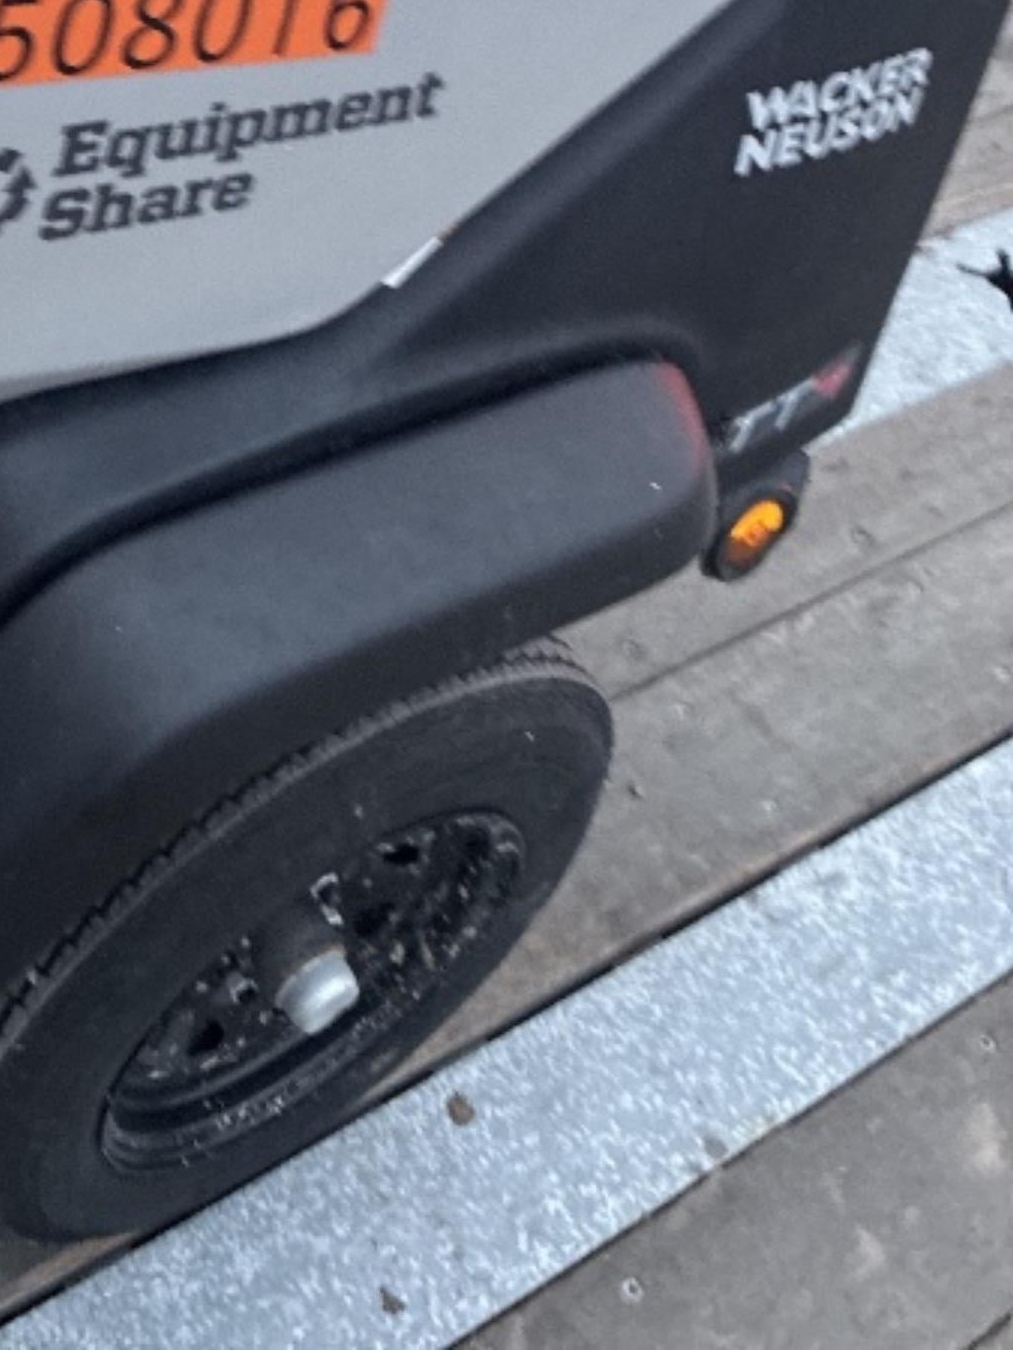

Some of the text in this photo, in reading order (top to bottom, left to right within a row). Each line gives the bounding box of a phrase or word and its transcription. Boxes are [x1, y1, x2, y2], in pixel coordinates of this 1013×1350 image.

[53, 72, 445, 178] Equipment
[734, 86, 925, 177] NEUSON
[746, 47, 934, 132] WACKER
[38, 172, 254, 241] Share
